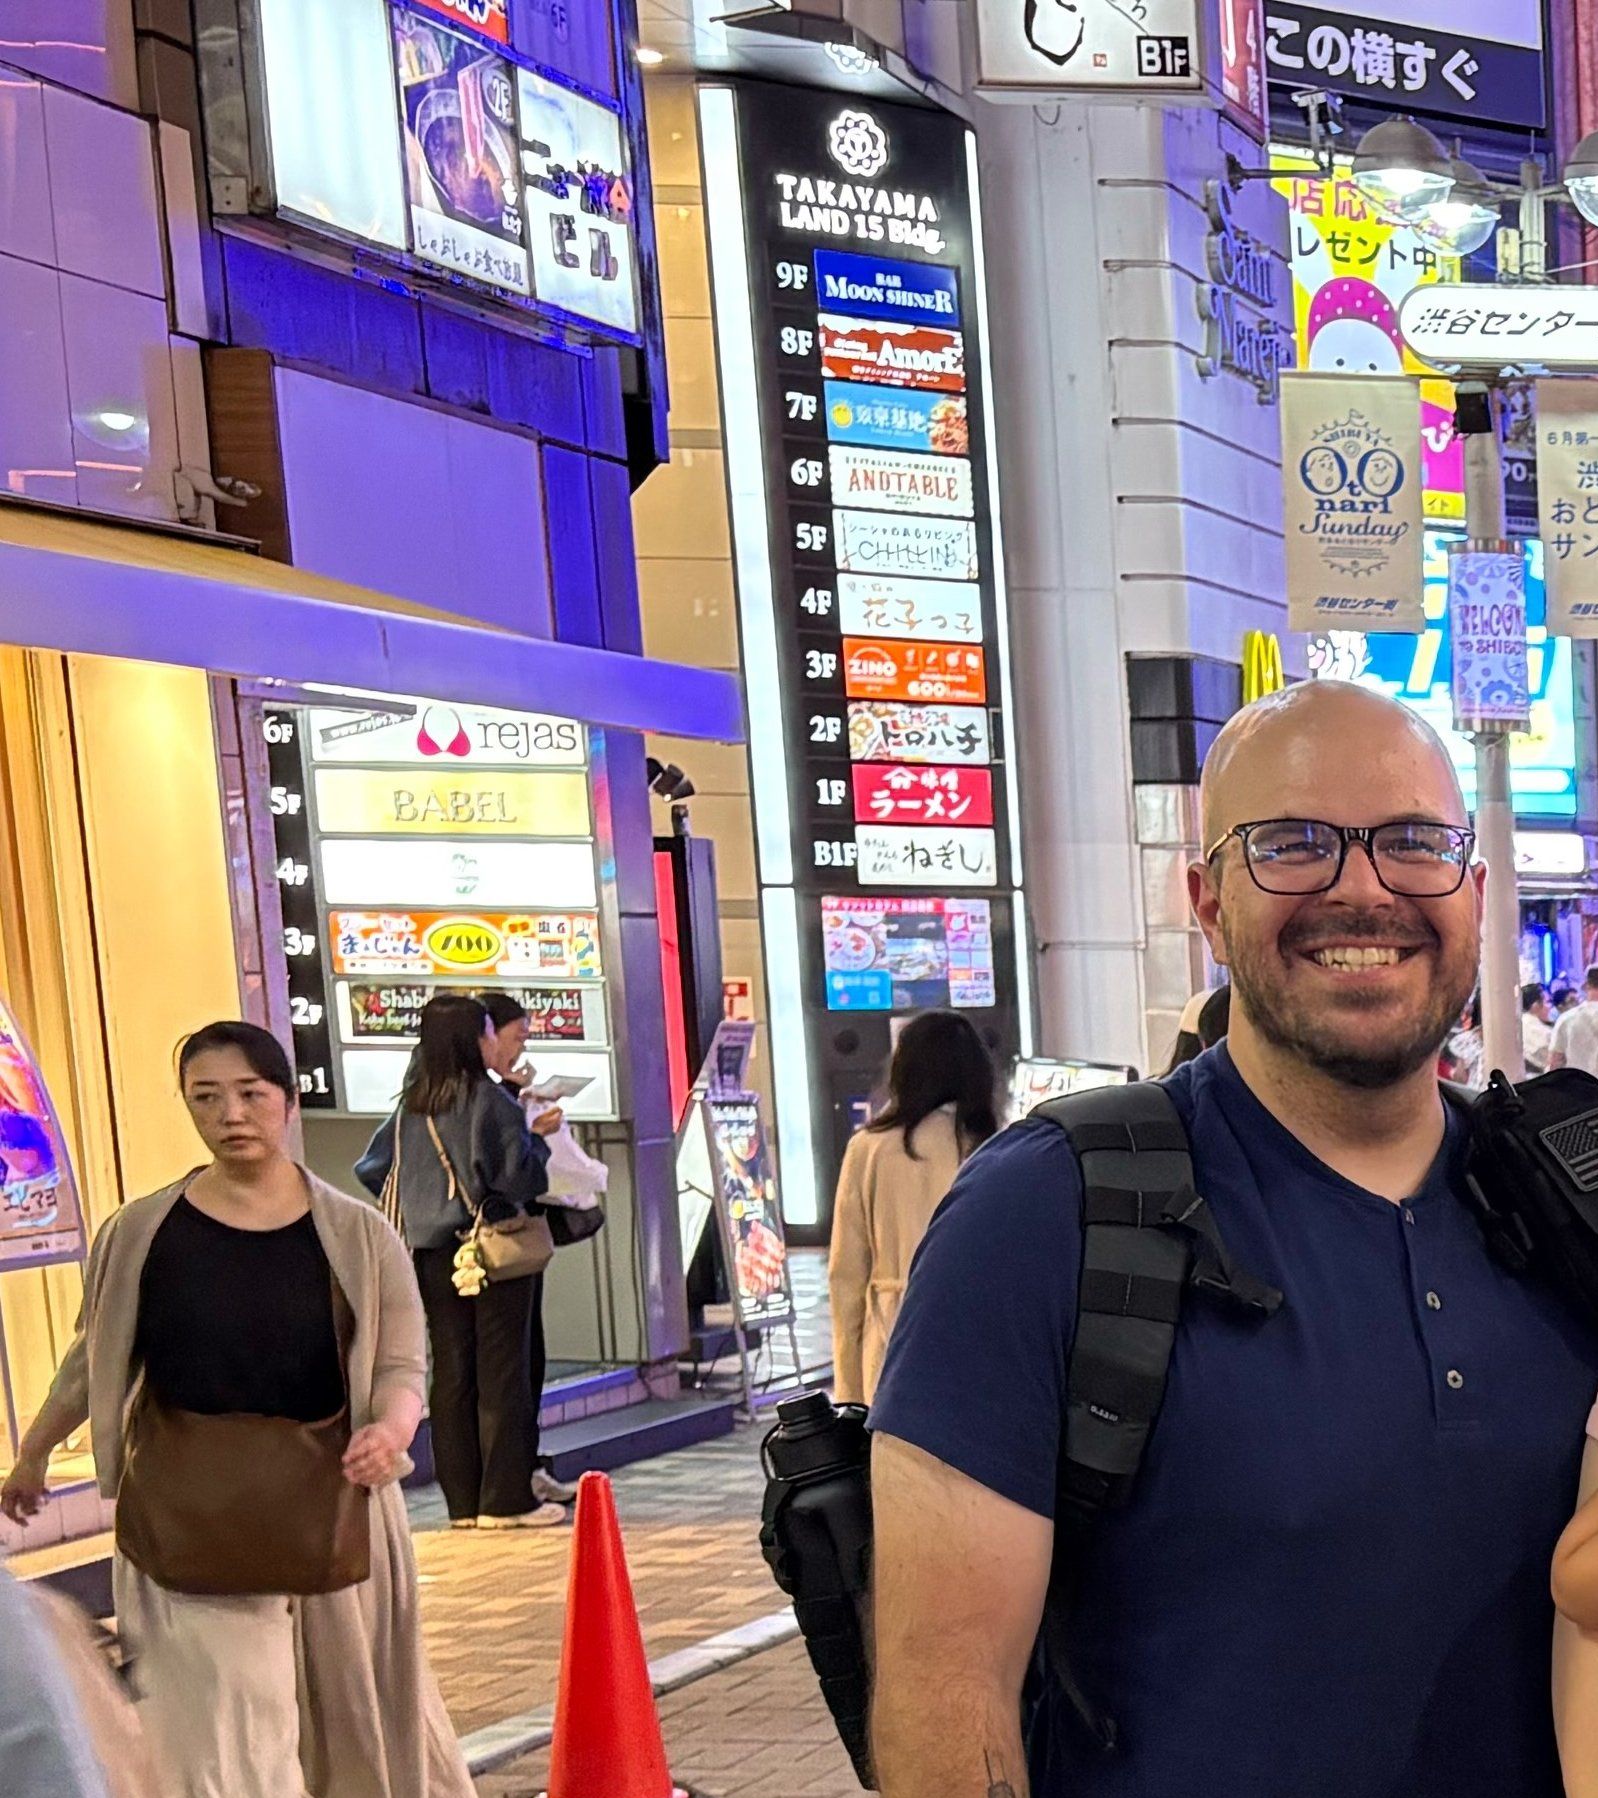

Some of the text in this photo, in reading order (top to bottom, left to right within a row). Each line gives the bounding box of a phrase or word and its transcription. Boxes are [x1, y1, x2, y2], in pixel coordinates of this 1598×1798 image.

[1140, 39, 1187, 75] B1F
[1265, 16, 1479, 101] この横すぐ
[775, 173, 938, 223] TAKAYAMA
[780, 202, 850, 235] LAND
[854, 214, 885, 240] 15
[776, 262, 808, 290] 9F
[780, 327, 813, 356] 8F
[785, 391, 817, 421] 7F
[790, 457, 823, 487] 6F
[1314, 496, 1393, 514] nari
[796, 522, 827, 551] 5F
[1299, 512, 1410, 541] Sunday
[800, 587, 832, 615] 4F
[1459, 603, 1524, 637] WELCOM
[805, 650, 837, 679] 3F
[262, 717, 293, 744] 6F
[477, 721, 578, 758] rejas
[809, 715, 841, 742] 2F
[269, 788, 301, 815] 5F
[393, 789, 518, 823] BABEL
[816, 779, 846, 805] 1F
[869, 789, 972, 820] ラーメン
[814, 840, 858, 867] B1F
[902, 840, 984, 875] ねぎし
[276, 857, 308, 887] 4F
[284, 928, 316, 956] 3F
[290, 997, 323, 1025] 2F
[514, 989, 580, 1016] kiyaki
